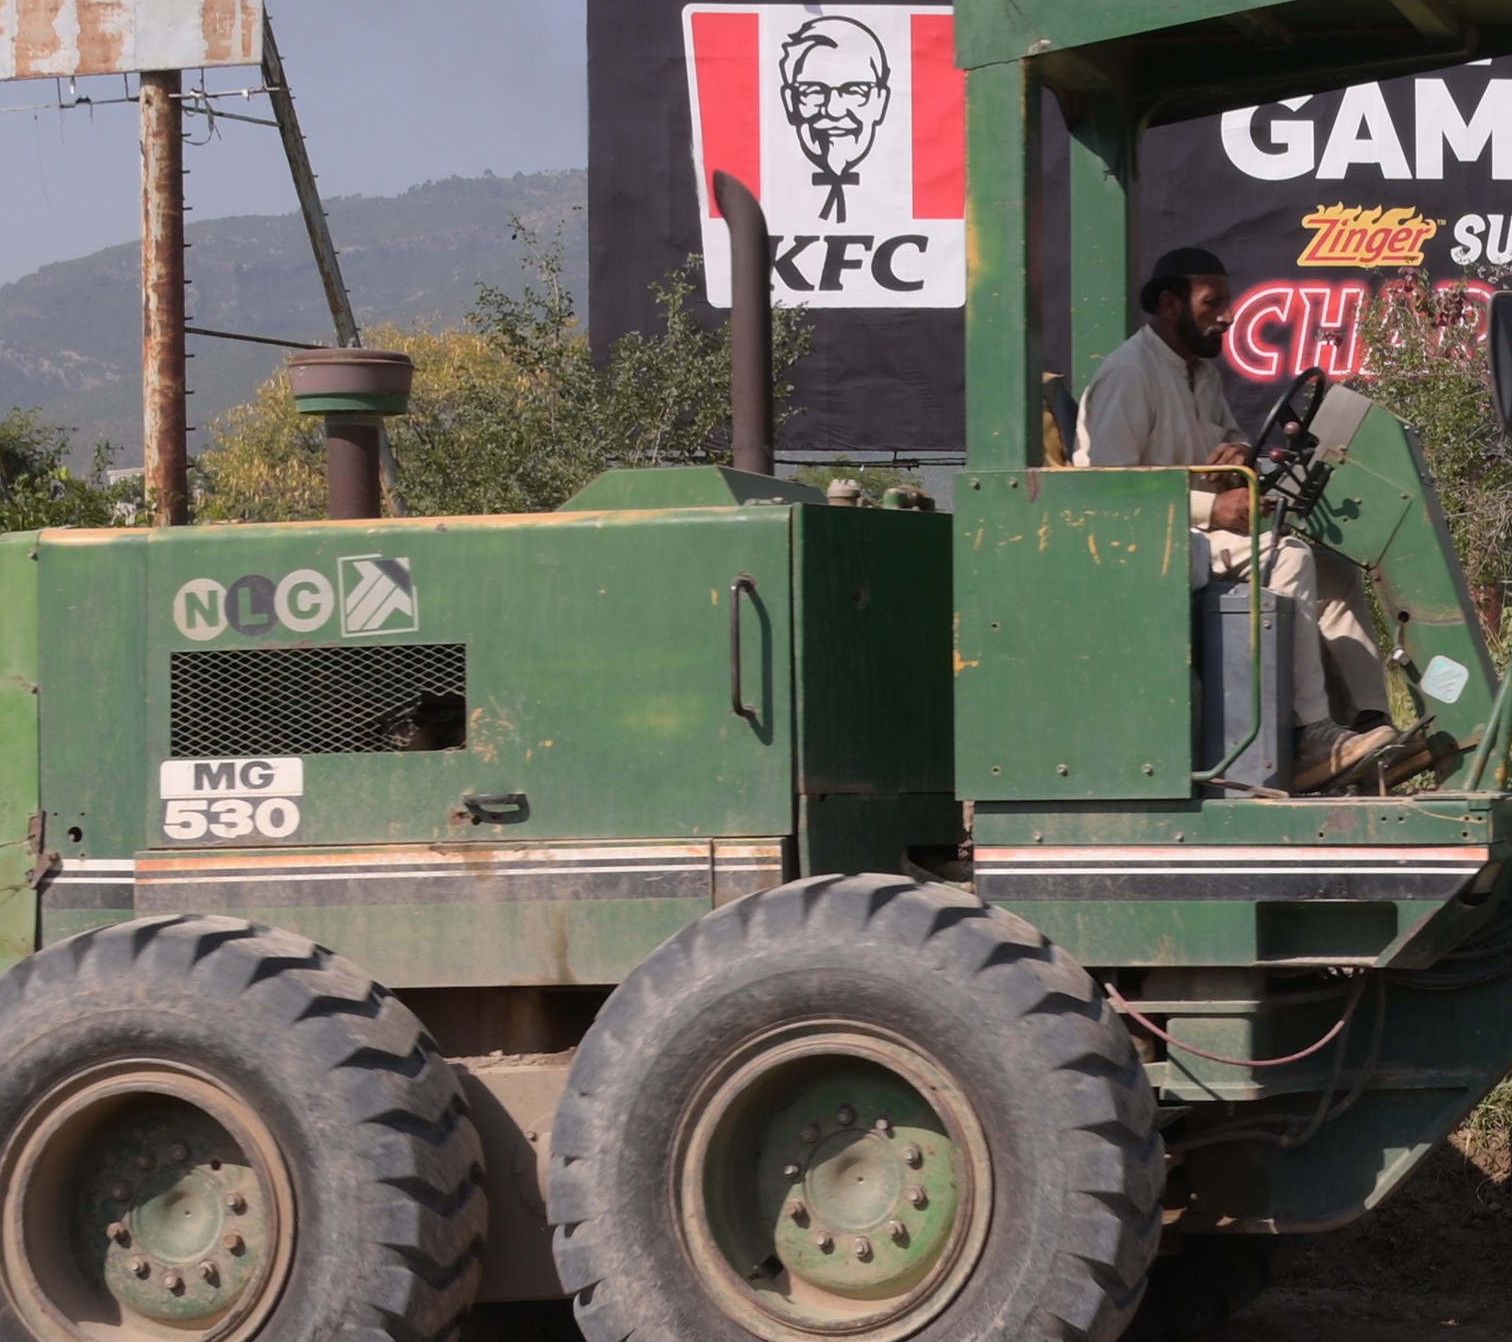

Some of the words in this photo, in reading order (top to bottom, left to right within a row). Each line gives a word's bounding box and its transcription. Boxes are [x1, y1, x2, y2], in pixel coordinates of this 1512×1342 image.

[768, 233, 929, 293] KFC
[1304, 215, 1434, 266] Zinger
[179, 575, 327, 634] NLC
[192, 759, 276, 792] MG
[162, 796, 301, 841] 530
